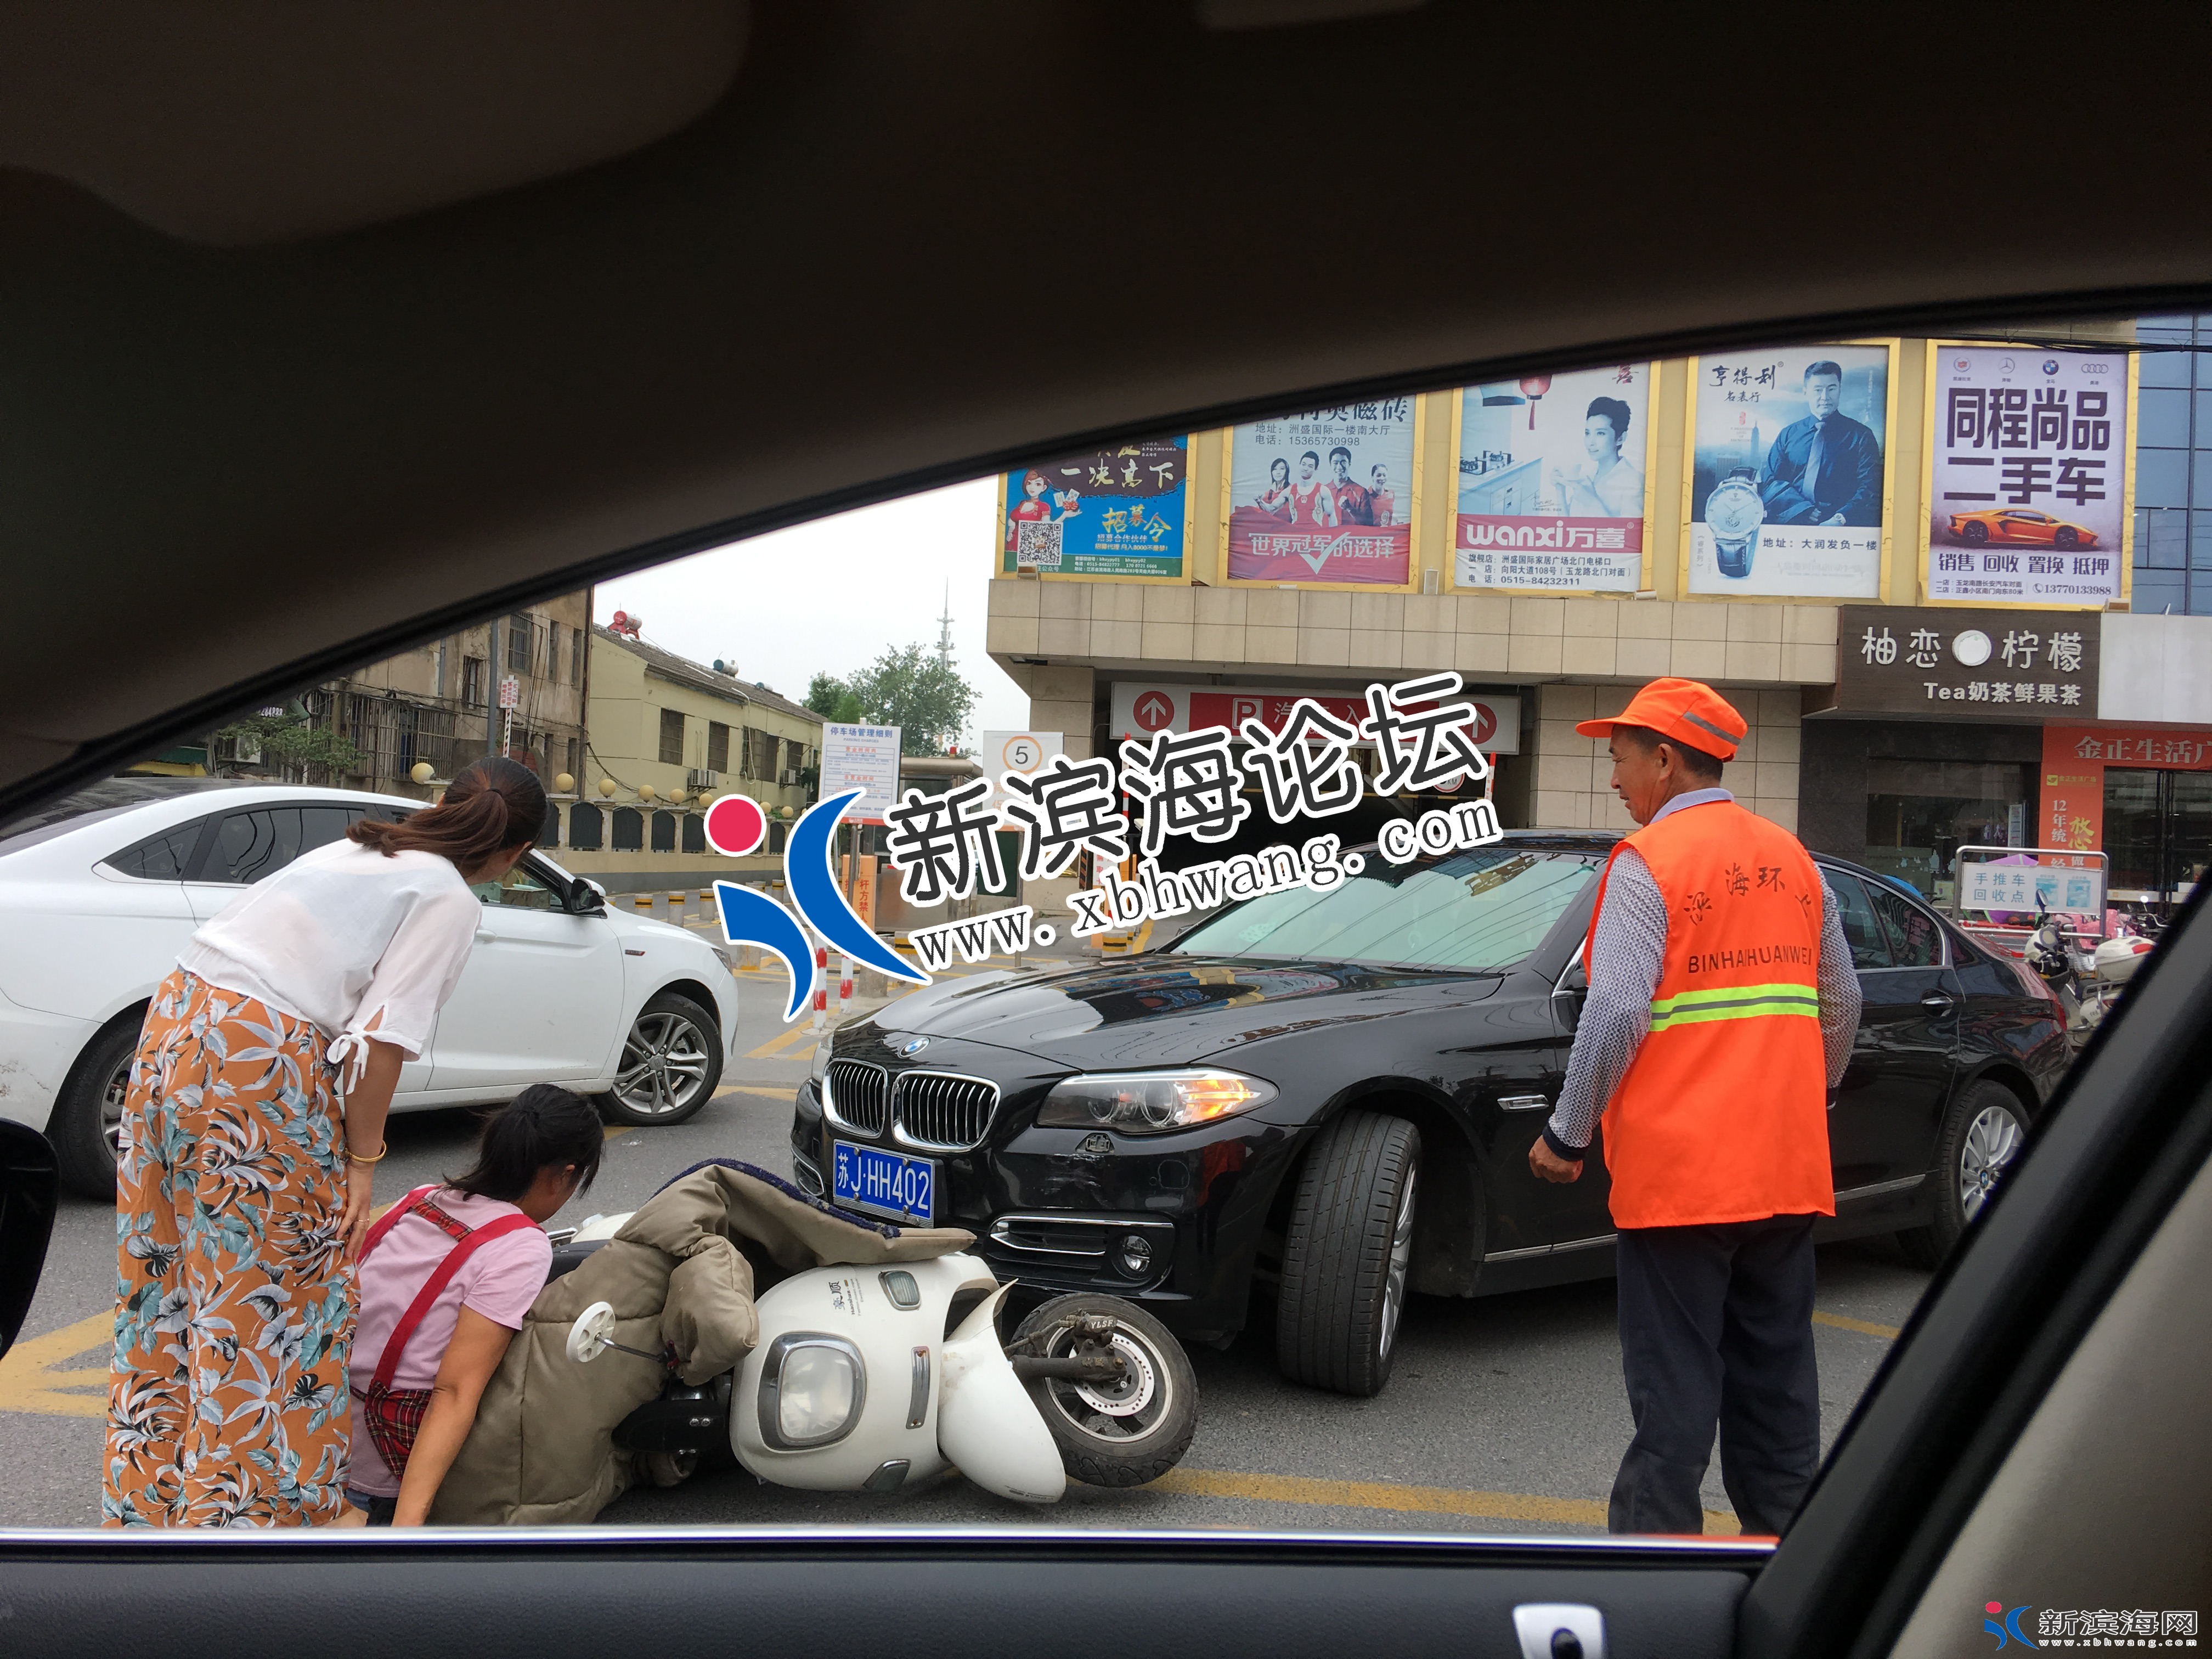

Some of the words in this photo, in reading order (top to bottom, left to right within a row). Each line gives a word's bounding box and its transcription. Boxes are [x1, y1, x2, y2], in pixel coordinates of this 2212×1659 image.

[1709, 364, 1776, 390] 亨得利
[1724, 391, 1761, 403] 名表行
[1946, 387, 2111, 451] 同程尚品
[1944, 457, 2106, 506] 二手车
[1102, 504, 1172, 543] 招募令
[1249, 533, 1395, 558] 世界冠军的选择
[1938, 553, 1975, 572] 销售
[1983, 555, 2020, 573] 回收
[2028, 556, 2064, 574] 置换
[2073, 557, 2109, 575] 抵押
[2044, 584, 2112, 595] 13770133988
[1861, 626, 1941, 668] 柚恋
[2001, 629, 2082, 673] 柠檬
[831, 727, 893, 738] 停车场管理细则
[1015, 746, 1028, 764] 5
[1974, 873, 2025, 887] 手推车
[1974, 889, 2025, 903] 回收点
